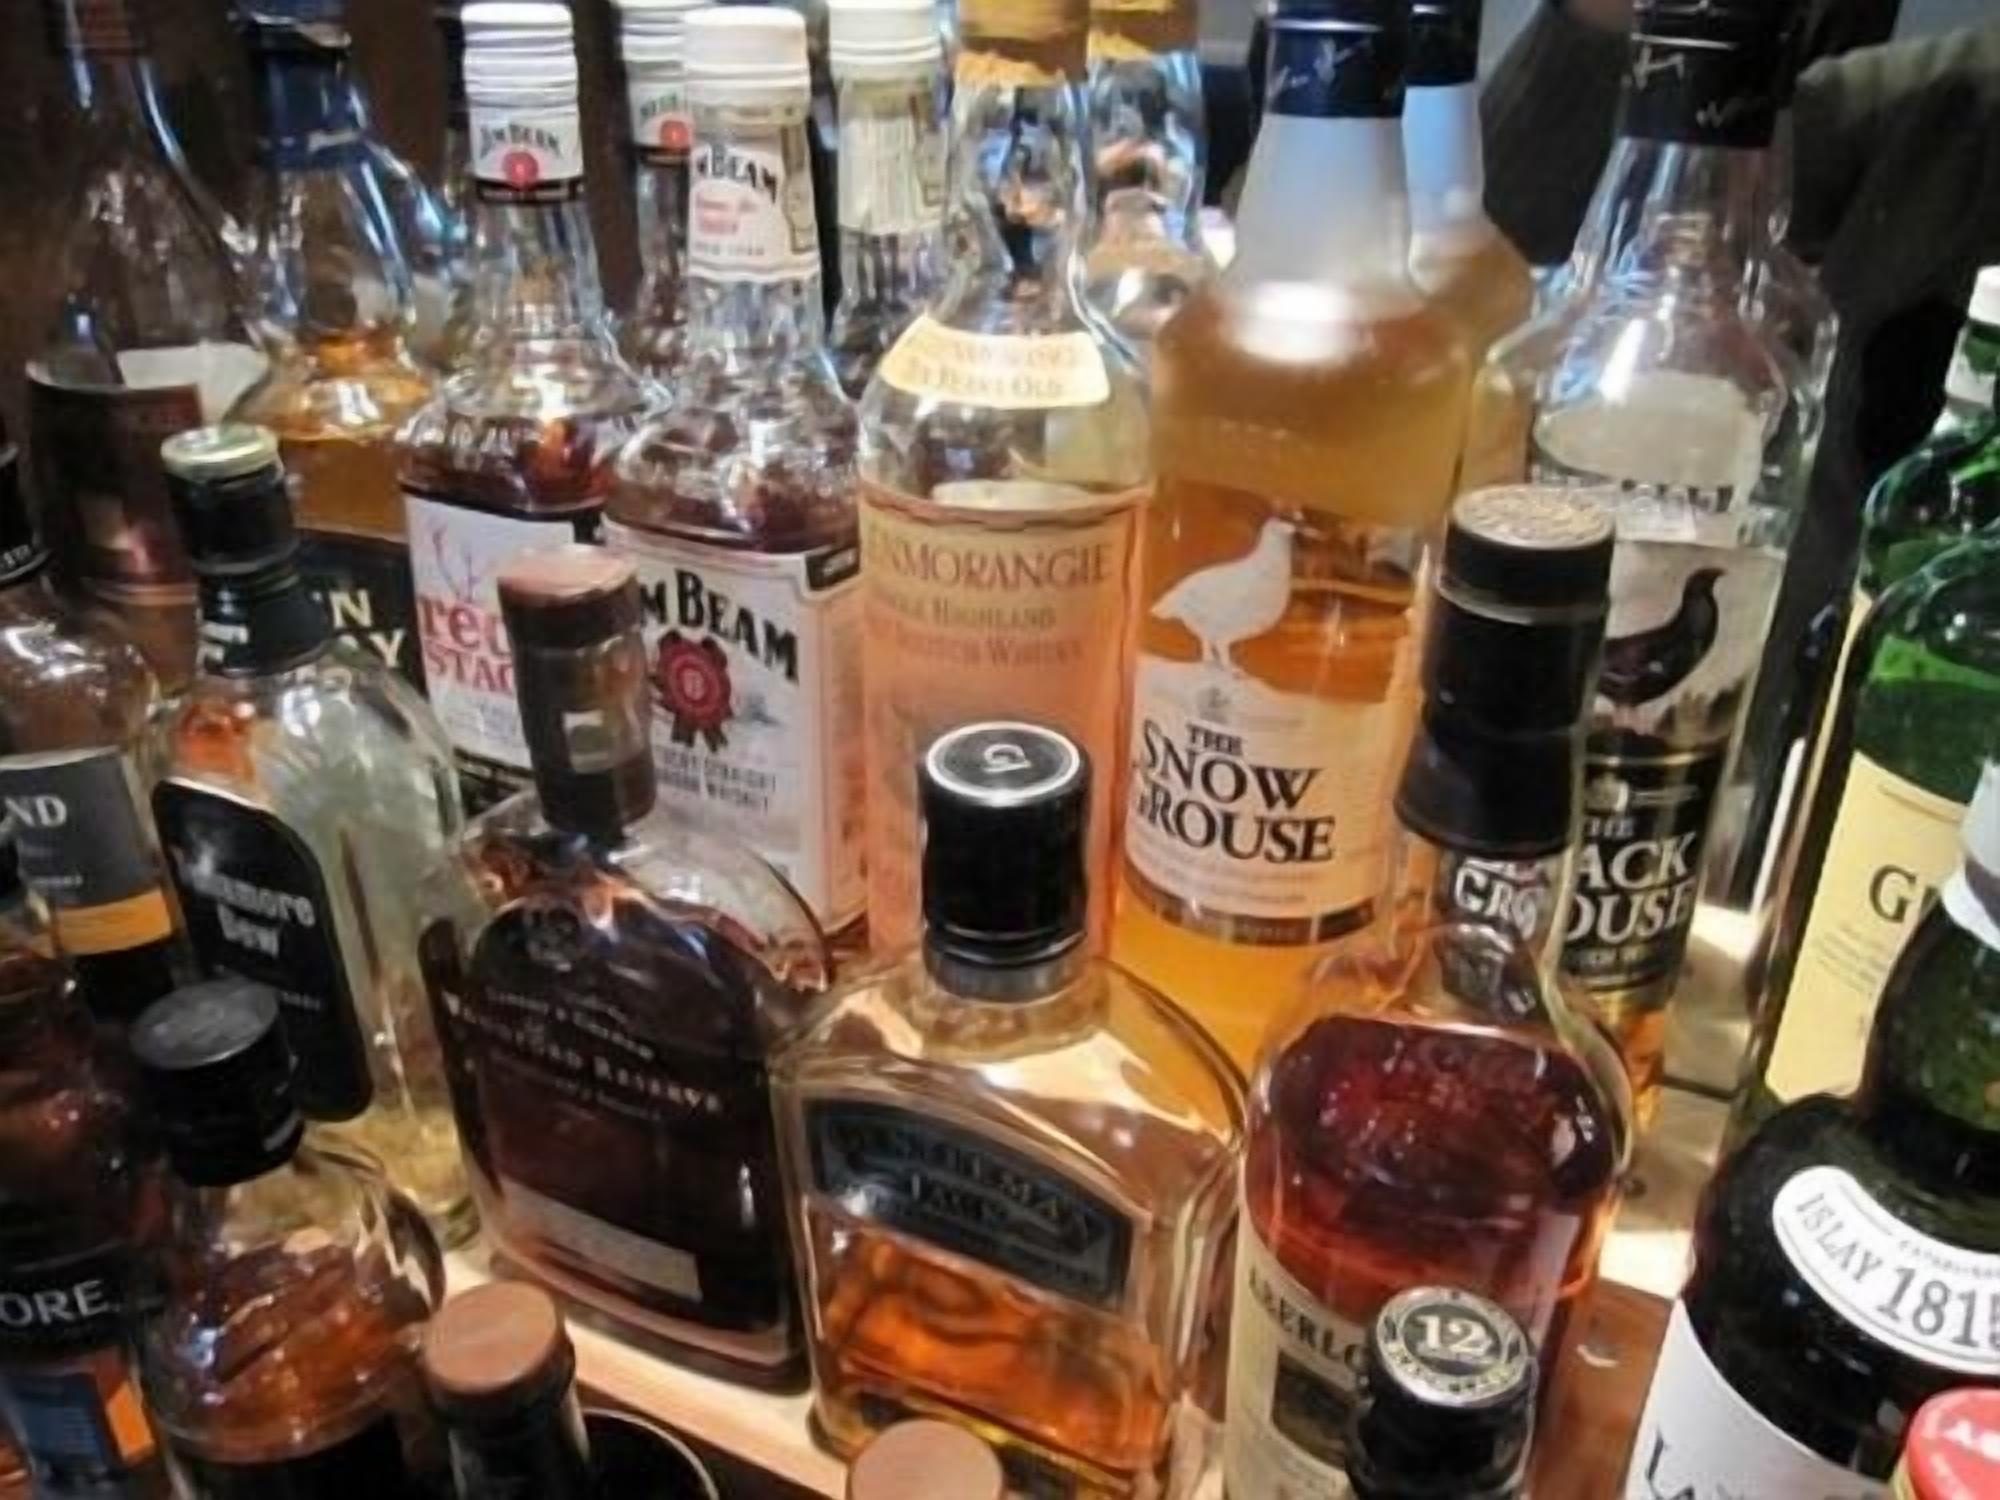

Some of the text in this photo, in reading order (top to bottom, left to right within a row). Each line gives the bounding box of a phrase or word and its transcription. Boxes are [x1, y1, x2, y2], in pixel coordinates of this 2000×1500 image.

[676, 568, 798, 683] BEAM
[1143, 719, 1325, 811] SNOW
[1186, 723, 1243, 755] THE
[1797, 1194, 1883, 1281] ISLAY
[1415, 1314, 1494, 1356] 12
